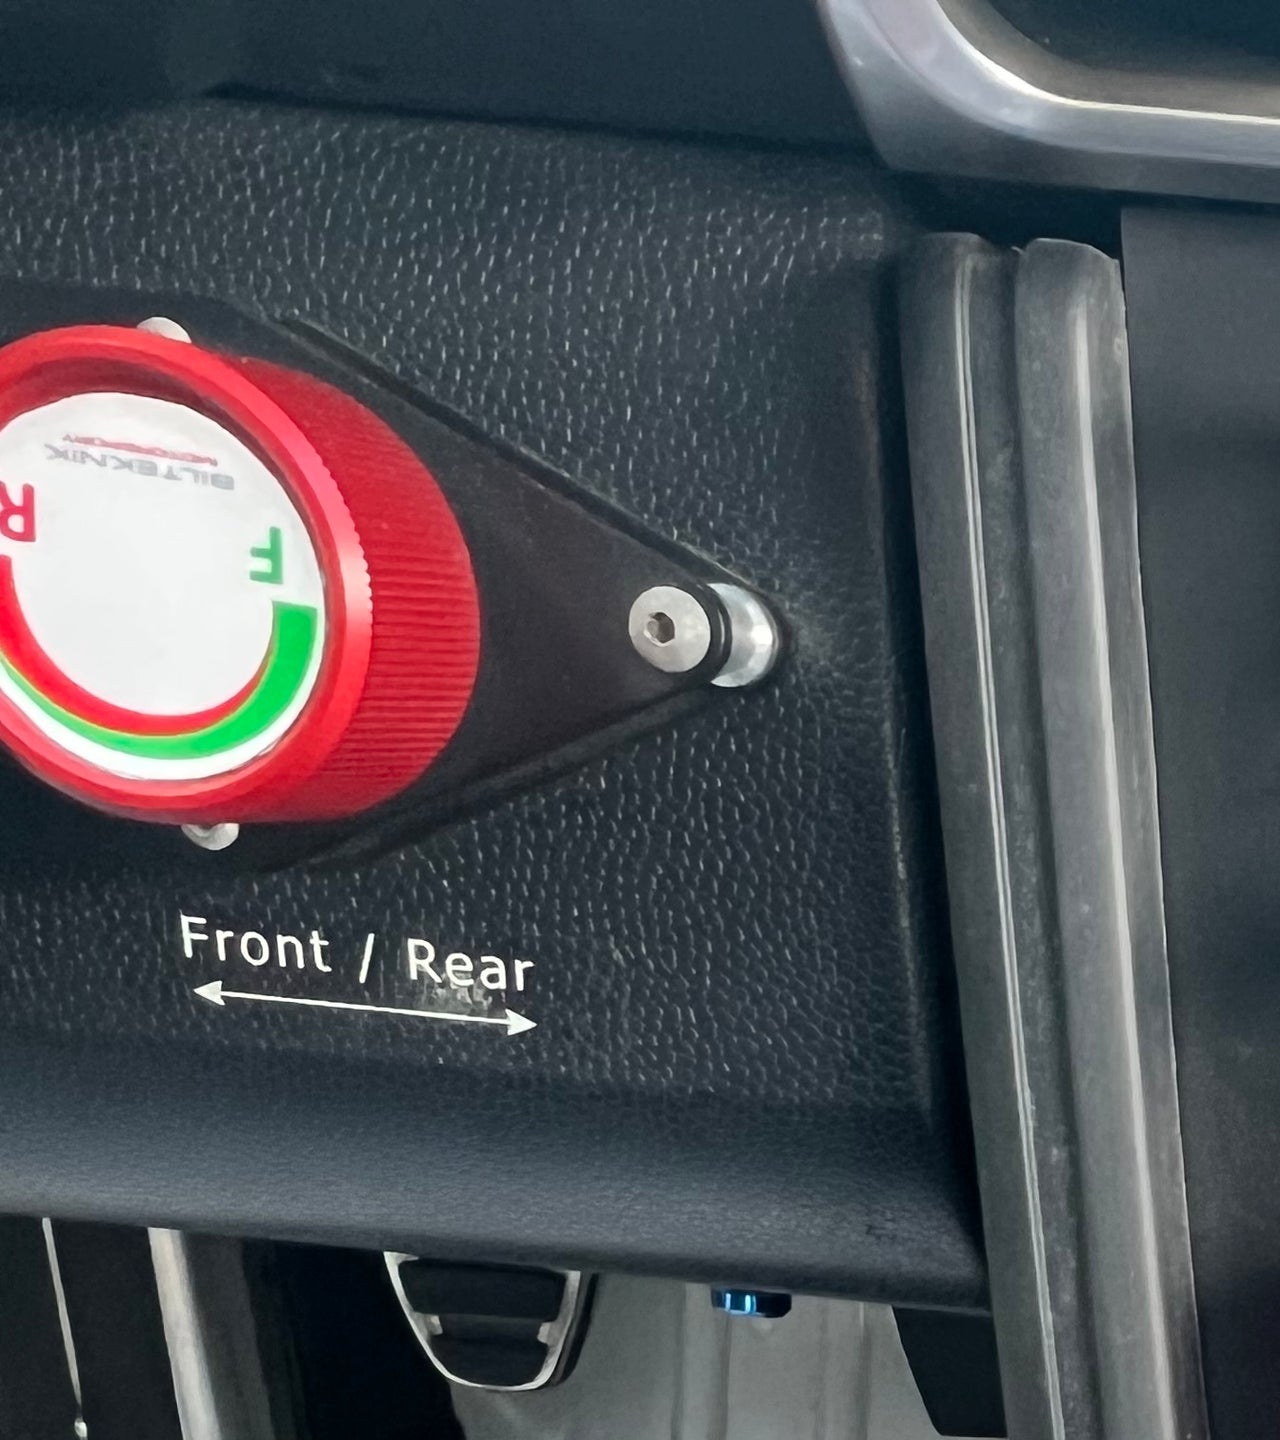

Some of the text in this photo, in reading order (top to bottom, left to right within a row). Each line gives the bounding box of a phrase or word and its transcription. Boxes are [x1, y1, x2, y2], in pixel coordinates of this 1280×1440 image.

[0, 480, 36, 542] R
[249, 526, 283, 585] F
[179, 912, 333, 973] Front
[407, 936, 535, 994] Rear
